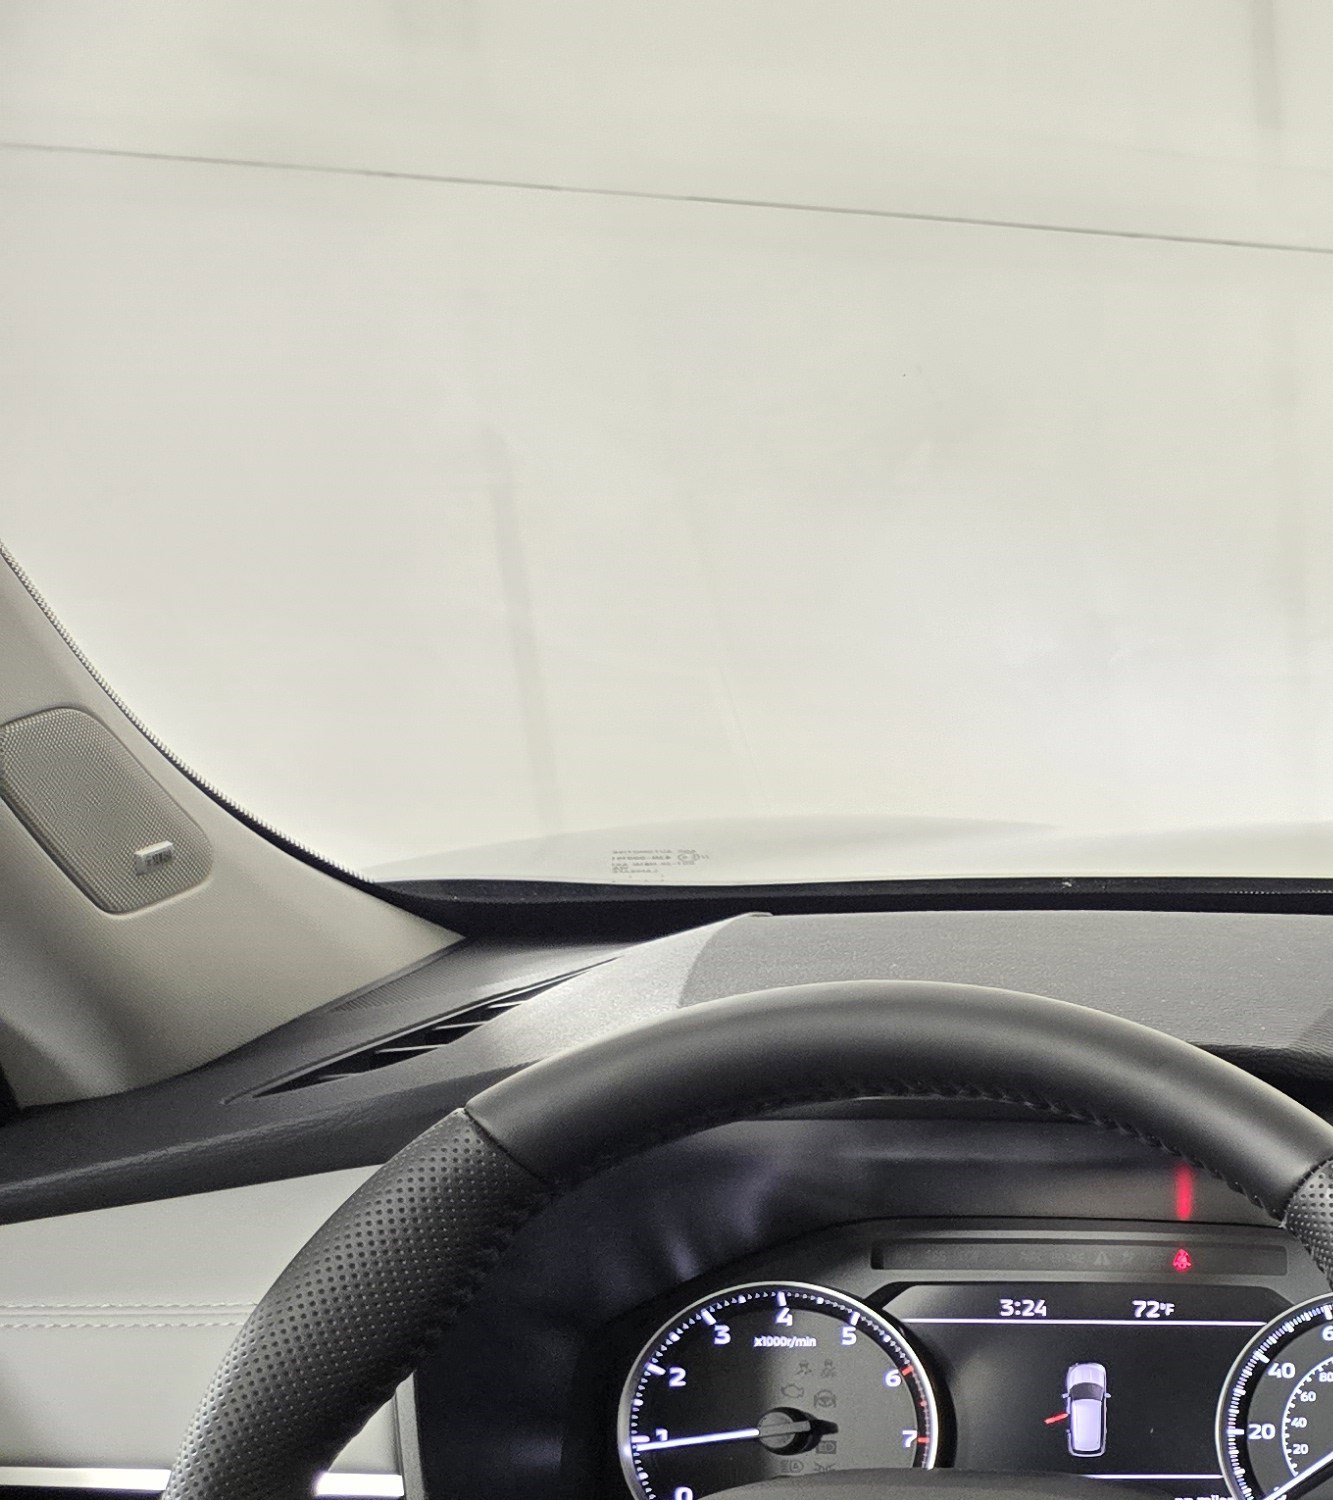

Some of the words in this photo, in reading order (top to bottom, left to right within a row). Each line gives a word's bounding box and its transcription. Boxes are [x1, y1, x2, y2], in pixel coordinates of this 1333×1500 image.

[1000, 1299, 1047, 1317] 3:24
[775, 1308, 794, 1327] 4
[713, 1325, 731, 1345] 3
[753, 1335, 817, 1350] x1000r/min
[841, 1326, 858, 1346] 5
[668, 1367, 687, 1387] 2
[885, 1369, 902, 1388] 6
[1267, 1362, 1296, 1379] 40
[1300, 1391, 1317, 1402] 60
[1248, 1423, 1276, 1440] 20
[1290, 1417, 1307, 1429] 40
[902, 1430, 917, 1448] 7
[1292, 1443, 1309, 1455] 20
